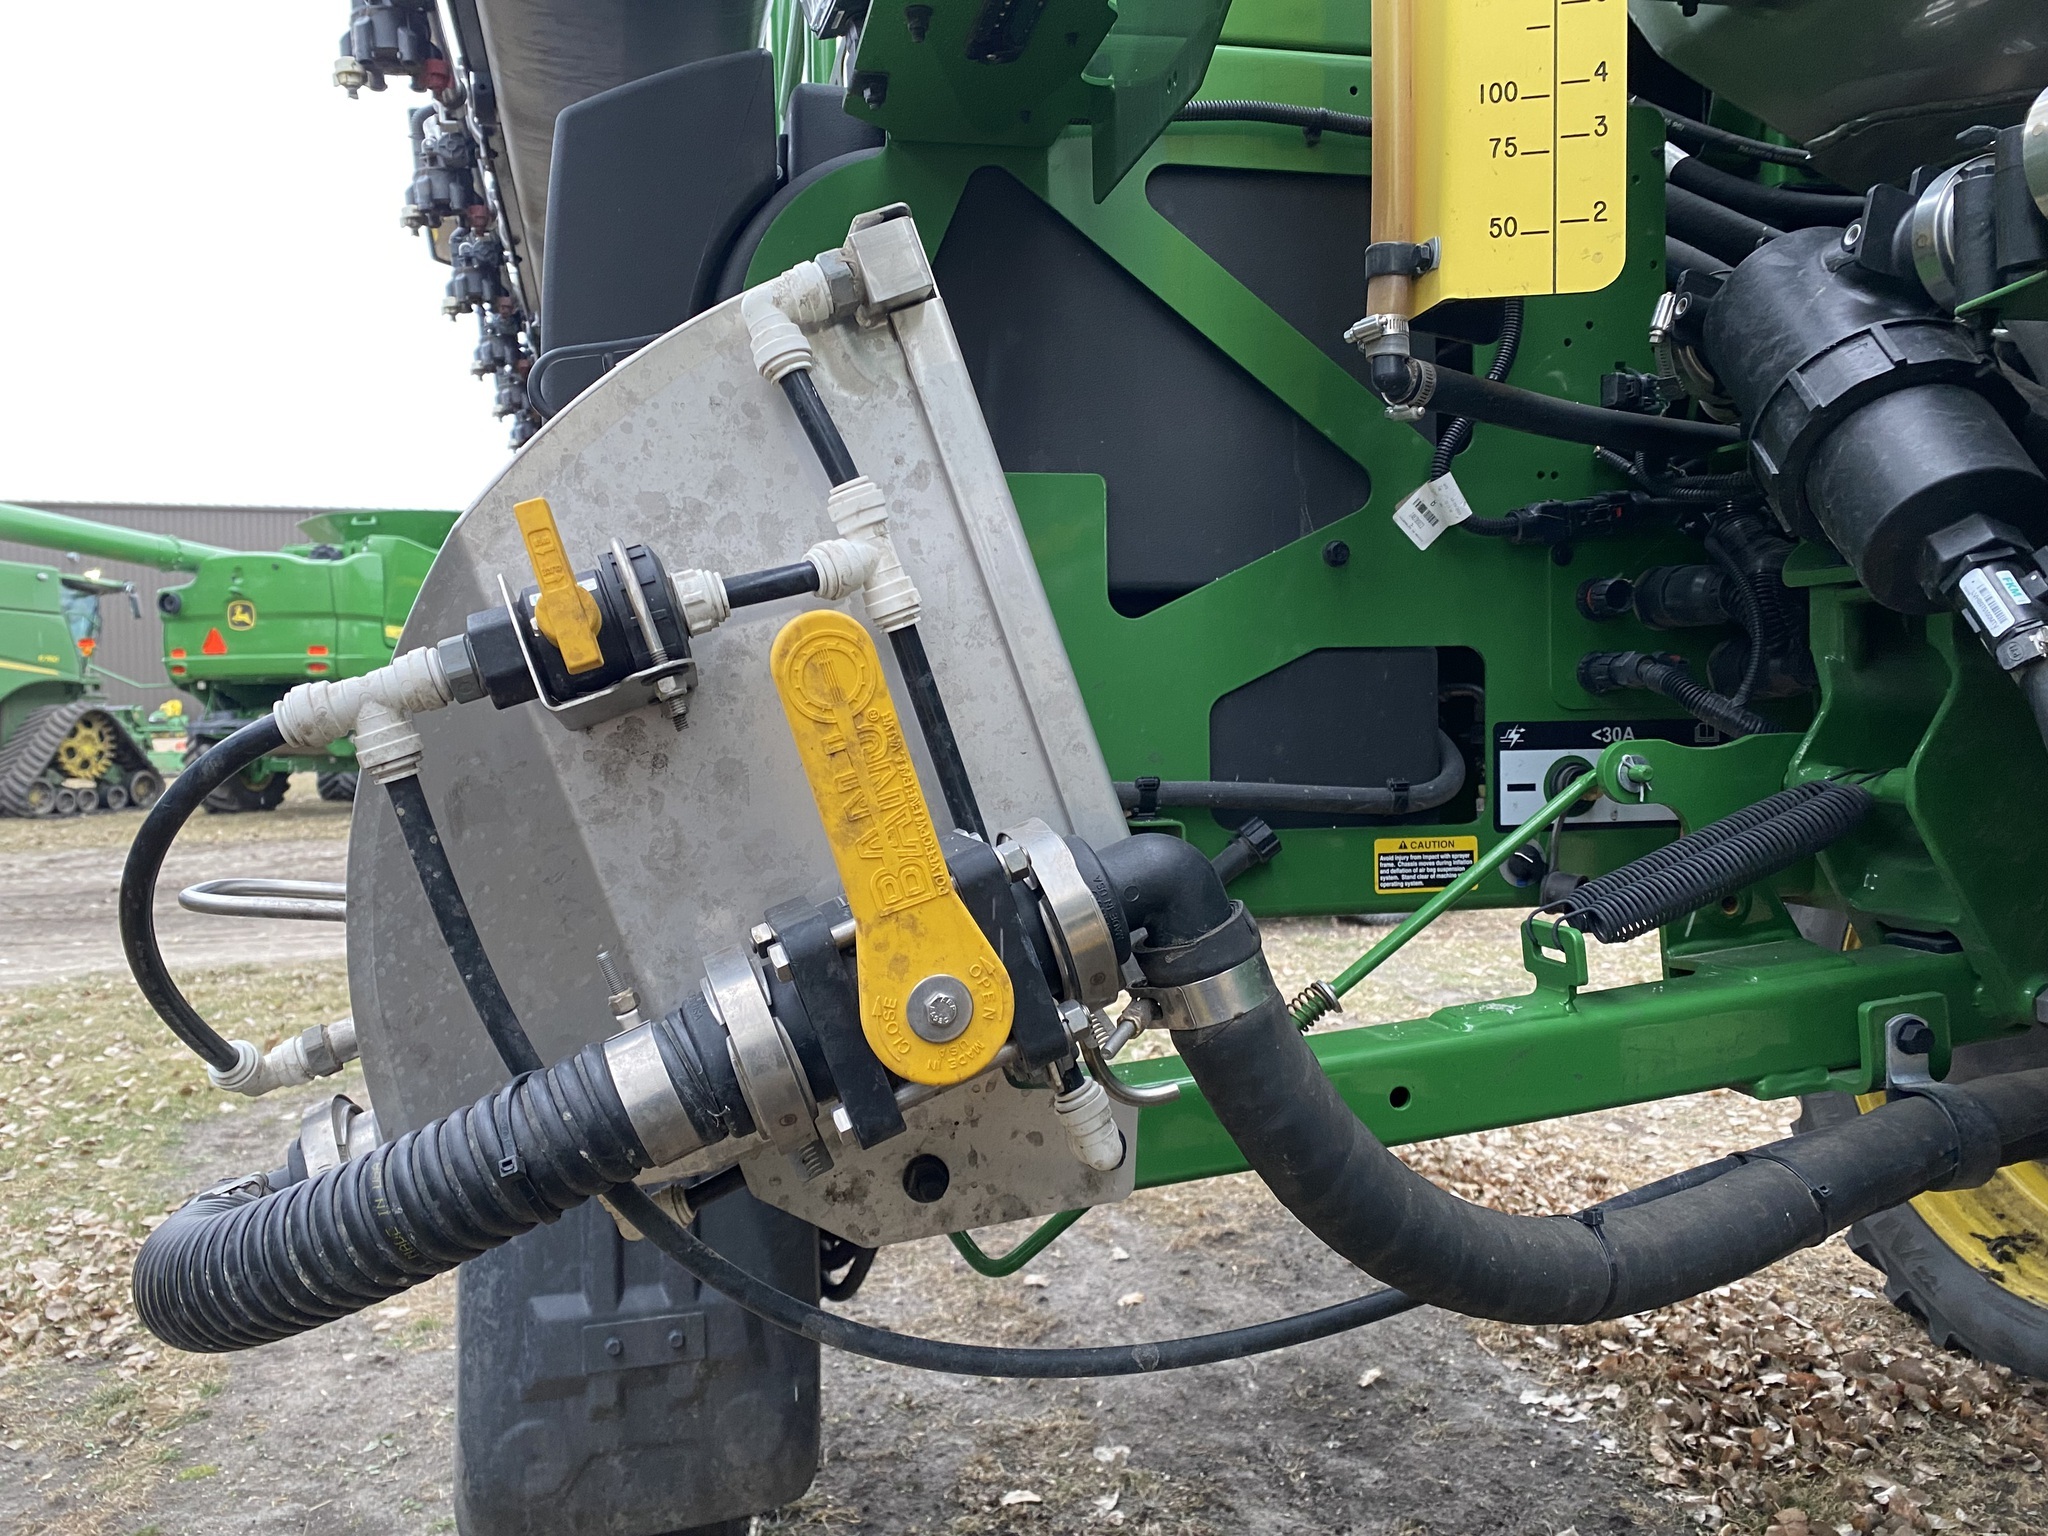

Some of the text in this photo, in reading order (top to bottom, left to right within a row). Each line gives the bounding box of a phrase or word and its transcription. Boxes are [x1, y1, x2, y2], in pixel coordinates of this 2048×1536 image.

[1594, 61, 1608, 82] 4
[1480, 81, 1518, 104] 100
[1594, 115, 1608, 137] 3
[1489, 137, 1517, 158] 75
[1593, 201, 1608, 222] 2
[1489, 216, 1517, 238] 50
[2002, 576, 2022, 597] FKM
[1410, 840, 1455, 849] CAUTION
[1380, 854, 1394, 862] Avoid
[1394, 854, 1409, 862] injury
[969, 964, 996, 1021] OPEN
[883, 997, 911, 1055] CLOSE
[927, 1039, 985, 1071] MADE IN
[938, 1039, 969, 1057] USA
[374, 1198, 391, 1216] IN
